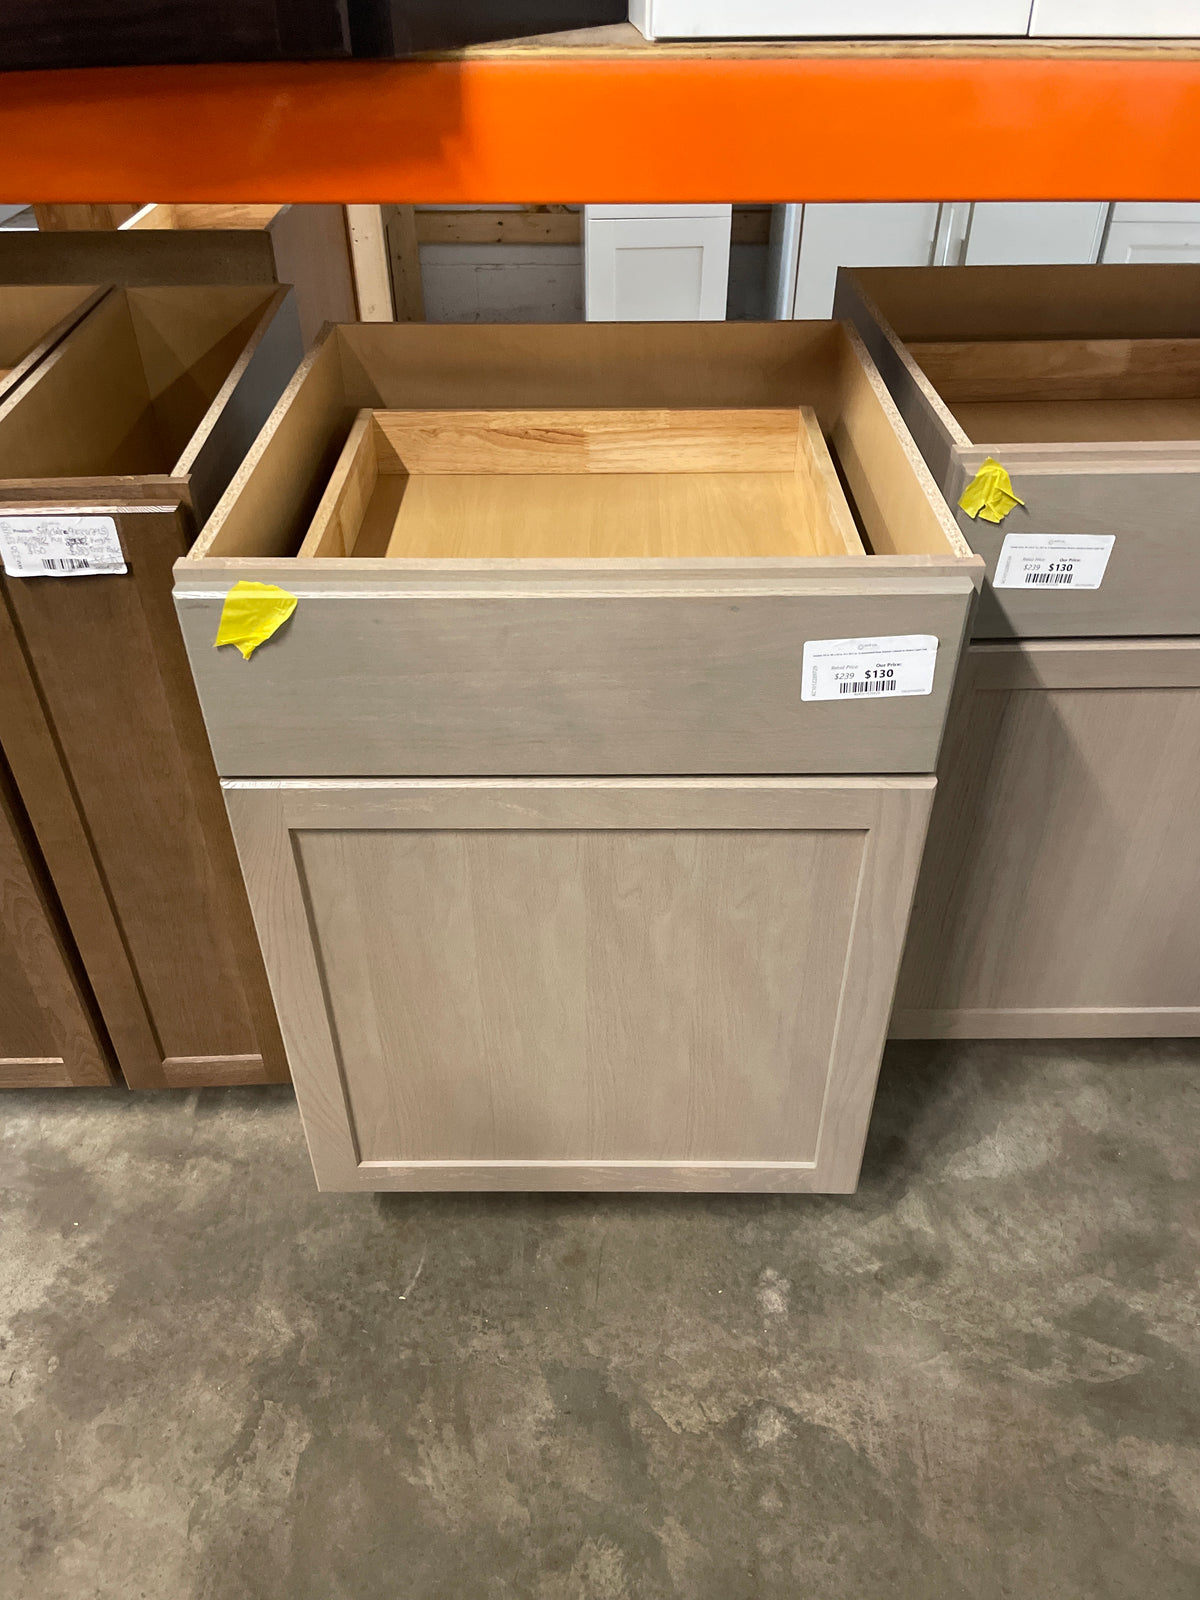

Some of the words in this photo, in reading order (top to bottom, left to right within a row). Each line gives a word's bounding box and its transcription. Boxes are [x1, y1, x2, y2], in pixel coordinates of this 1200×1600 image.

[1048, 563, 1073, 572] $130
[834, 672, 855, 680] $239
[864, 669, 894, 680] $130
